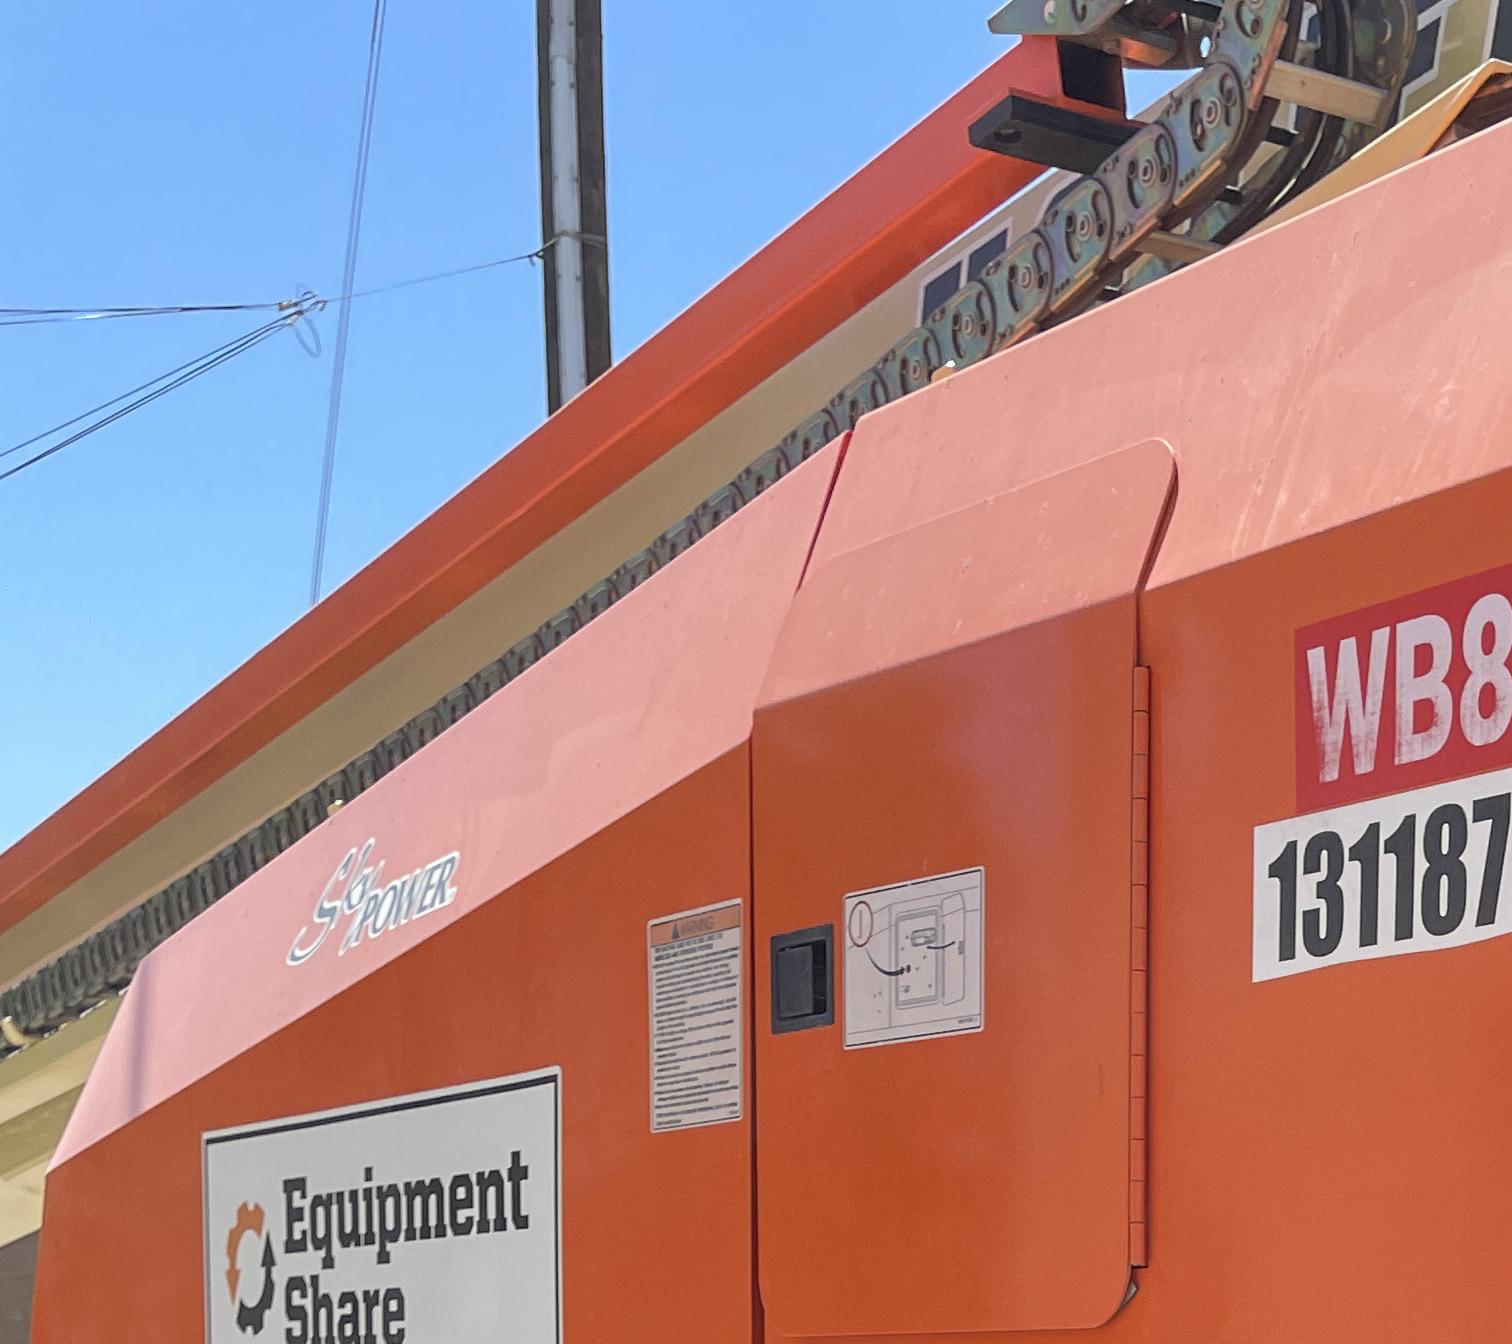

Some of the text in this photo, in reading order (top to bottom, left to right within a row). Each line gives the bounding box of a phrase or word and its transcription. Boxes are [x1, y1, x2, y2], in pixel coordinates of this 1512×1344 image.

[349, 851, 460, 948] POWER
[1267, 792, 1512, 962] 131187
[283, 1150, 529, 1270] Equipment
